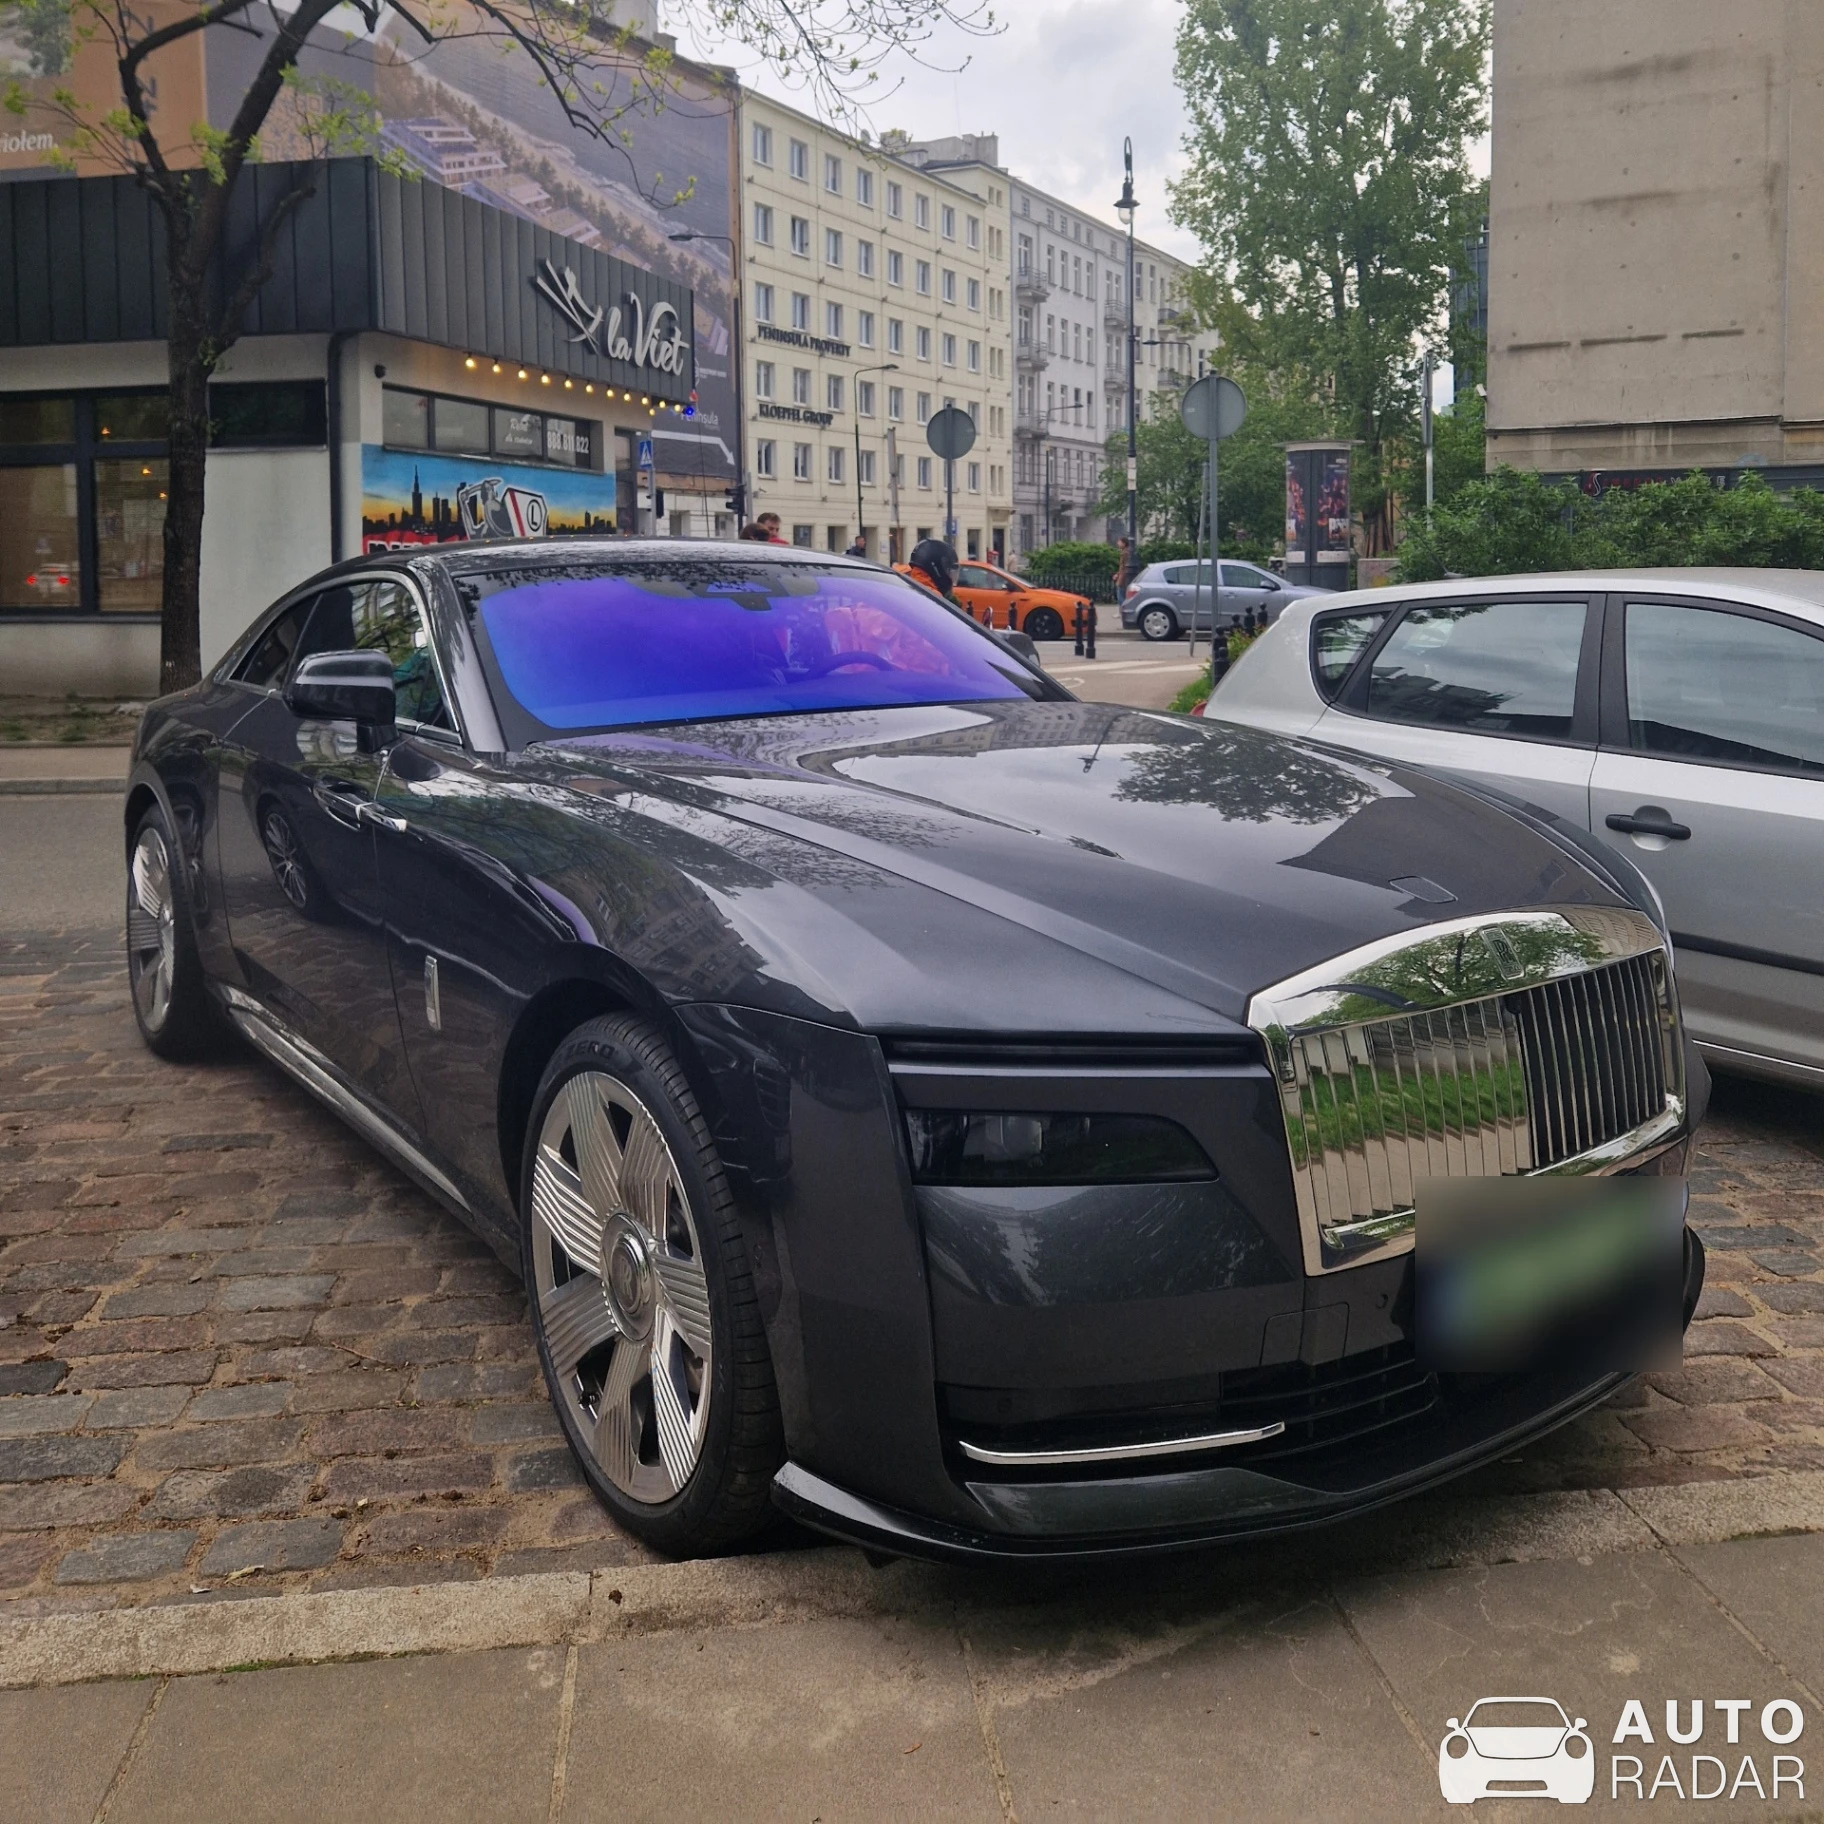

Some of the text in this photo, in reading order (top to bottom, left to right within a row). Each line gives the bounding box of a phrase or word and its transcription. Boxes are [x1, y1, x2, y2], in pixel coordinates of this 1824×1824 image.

[0, 130, 59, 154] iołem.
[608, 292, 690, 376] la Viet
[757, 325, 852, 357] PENINSULA PROPERTY
[803, 410, 834, 426] GROUP
[575, 435, 590, 454] 822
